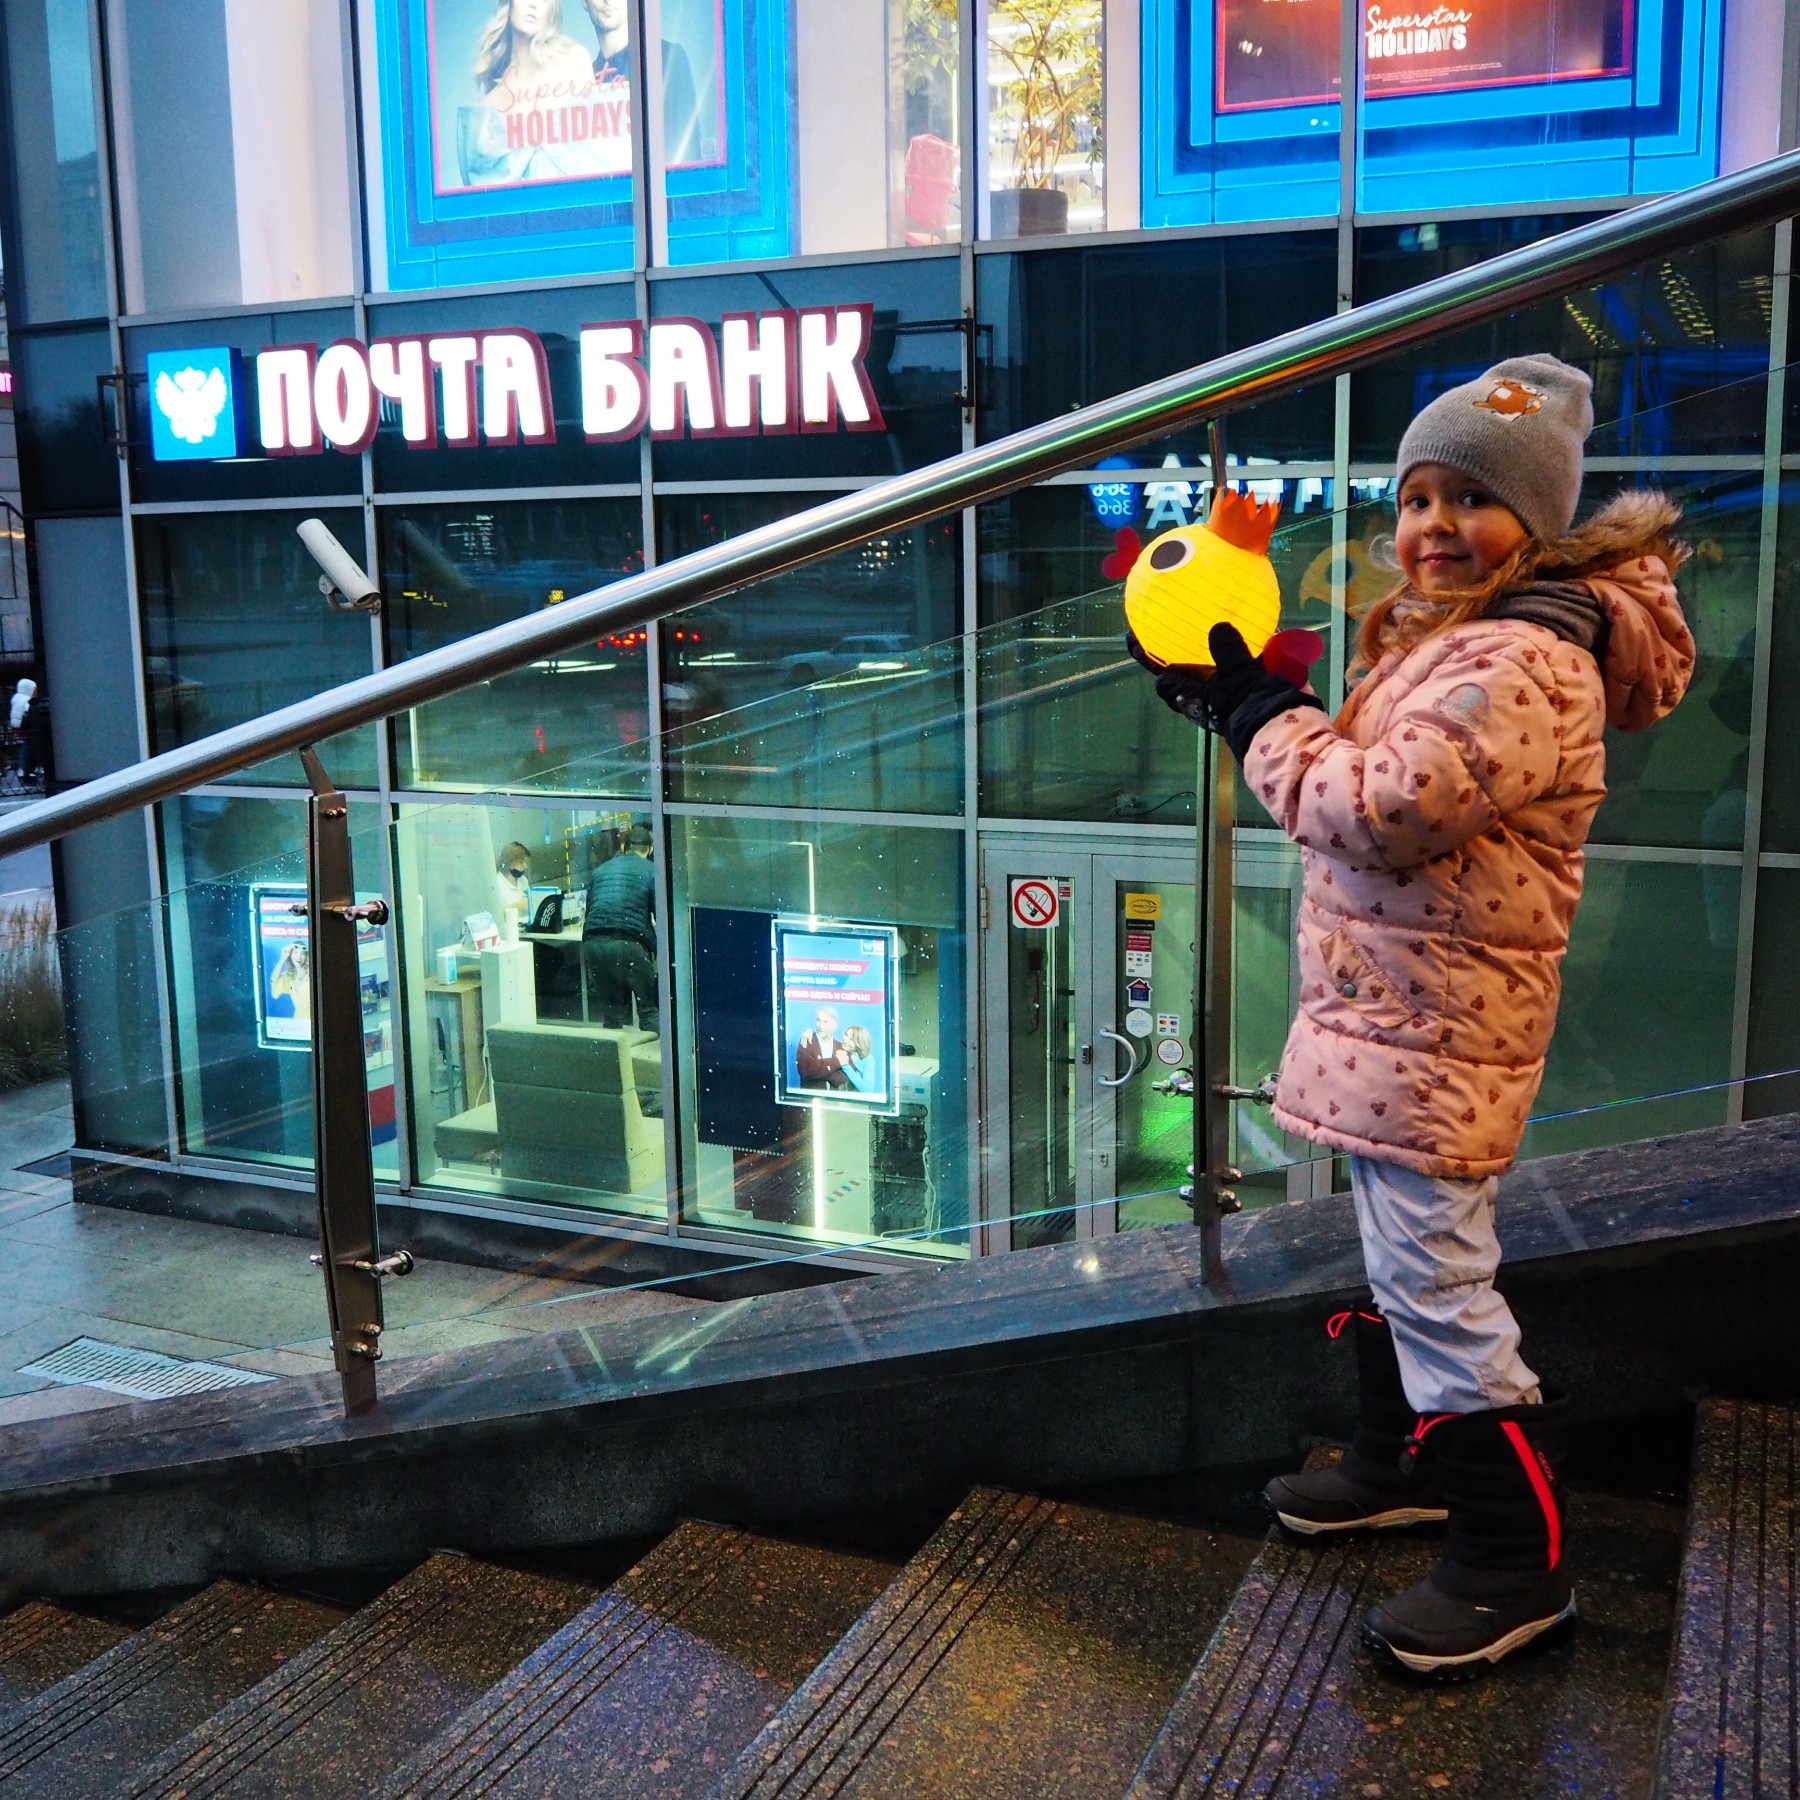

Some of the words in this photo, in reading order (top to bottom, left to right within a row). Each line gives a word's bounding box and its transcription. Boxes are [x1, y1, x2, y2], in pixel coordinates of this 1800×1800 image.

[1365, 4, 1473, 38] Superstar
[1368, 24, 1467, 59] HOLIDAYS
[497, 61, 630, 113] Supersta
[256, 329, 554, 453] ПОЧТА
[579, 305, 882, 440] БАНК
[840, 992, 871, 1002] СЕЙЧАС
